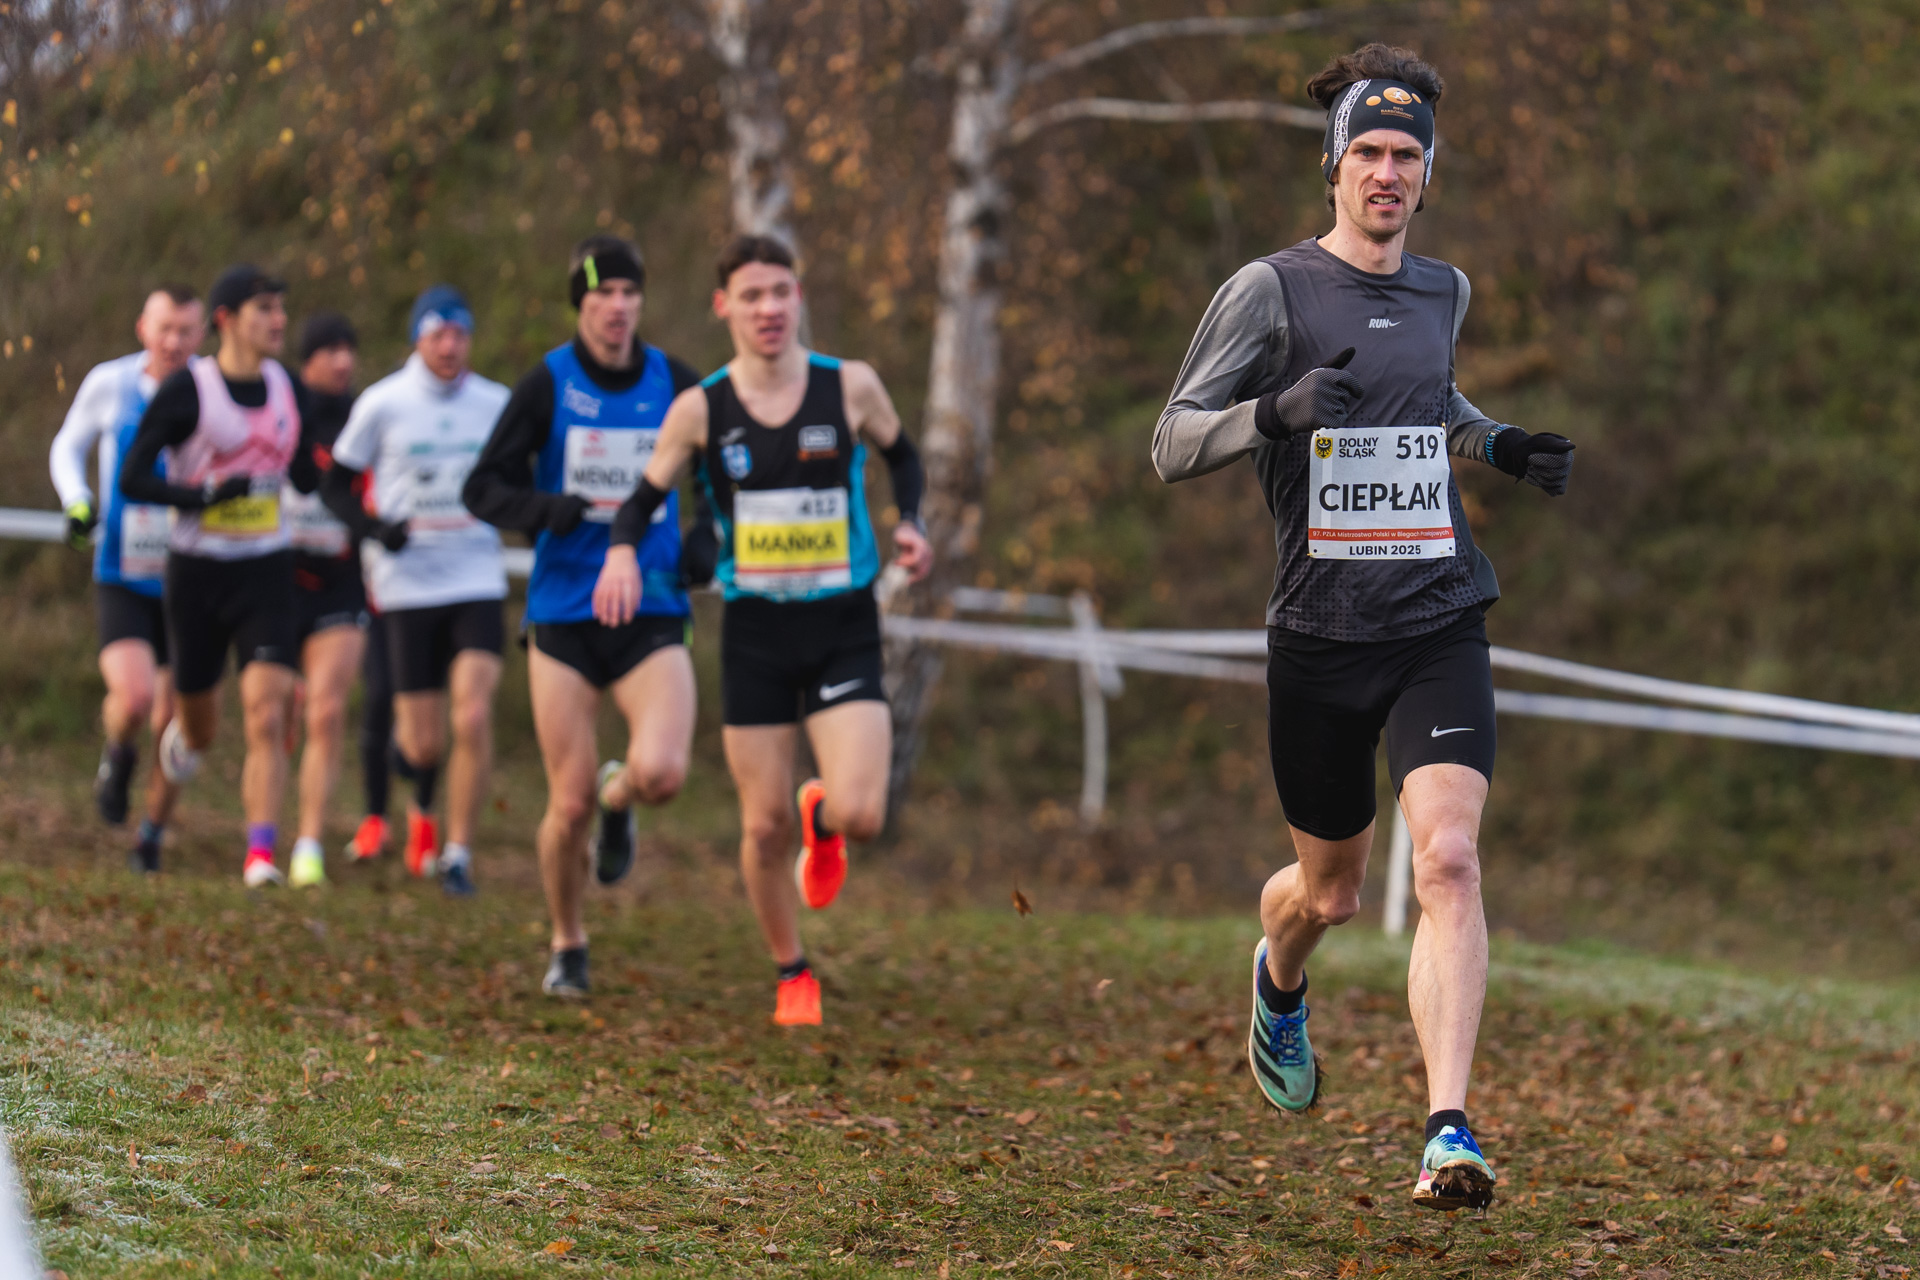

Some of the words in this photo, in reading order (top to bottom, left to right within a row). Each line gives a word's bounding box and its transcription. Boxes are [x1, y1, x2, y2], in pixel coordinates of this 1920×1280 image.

[1368, 318, 1390, 329] RUN
[1338, 437, 1379, 448] DOLNY
[1395, 434, 1439, 460] 519
[1338, 447, 1377, 459] ŚLĄSK
[1318, 481, 1442, 512] CIEPŁAK
[1349, 545, 1388, 556] LUBIN
[1390, 544, 1421, 555] 2025
